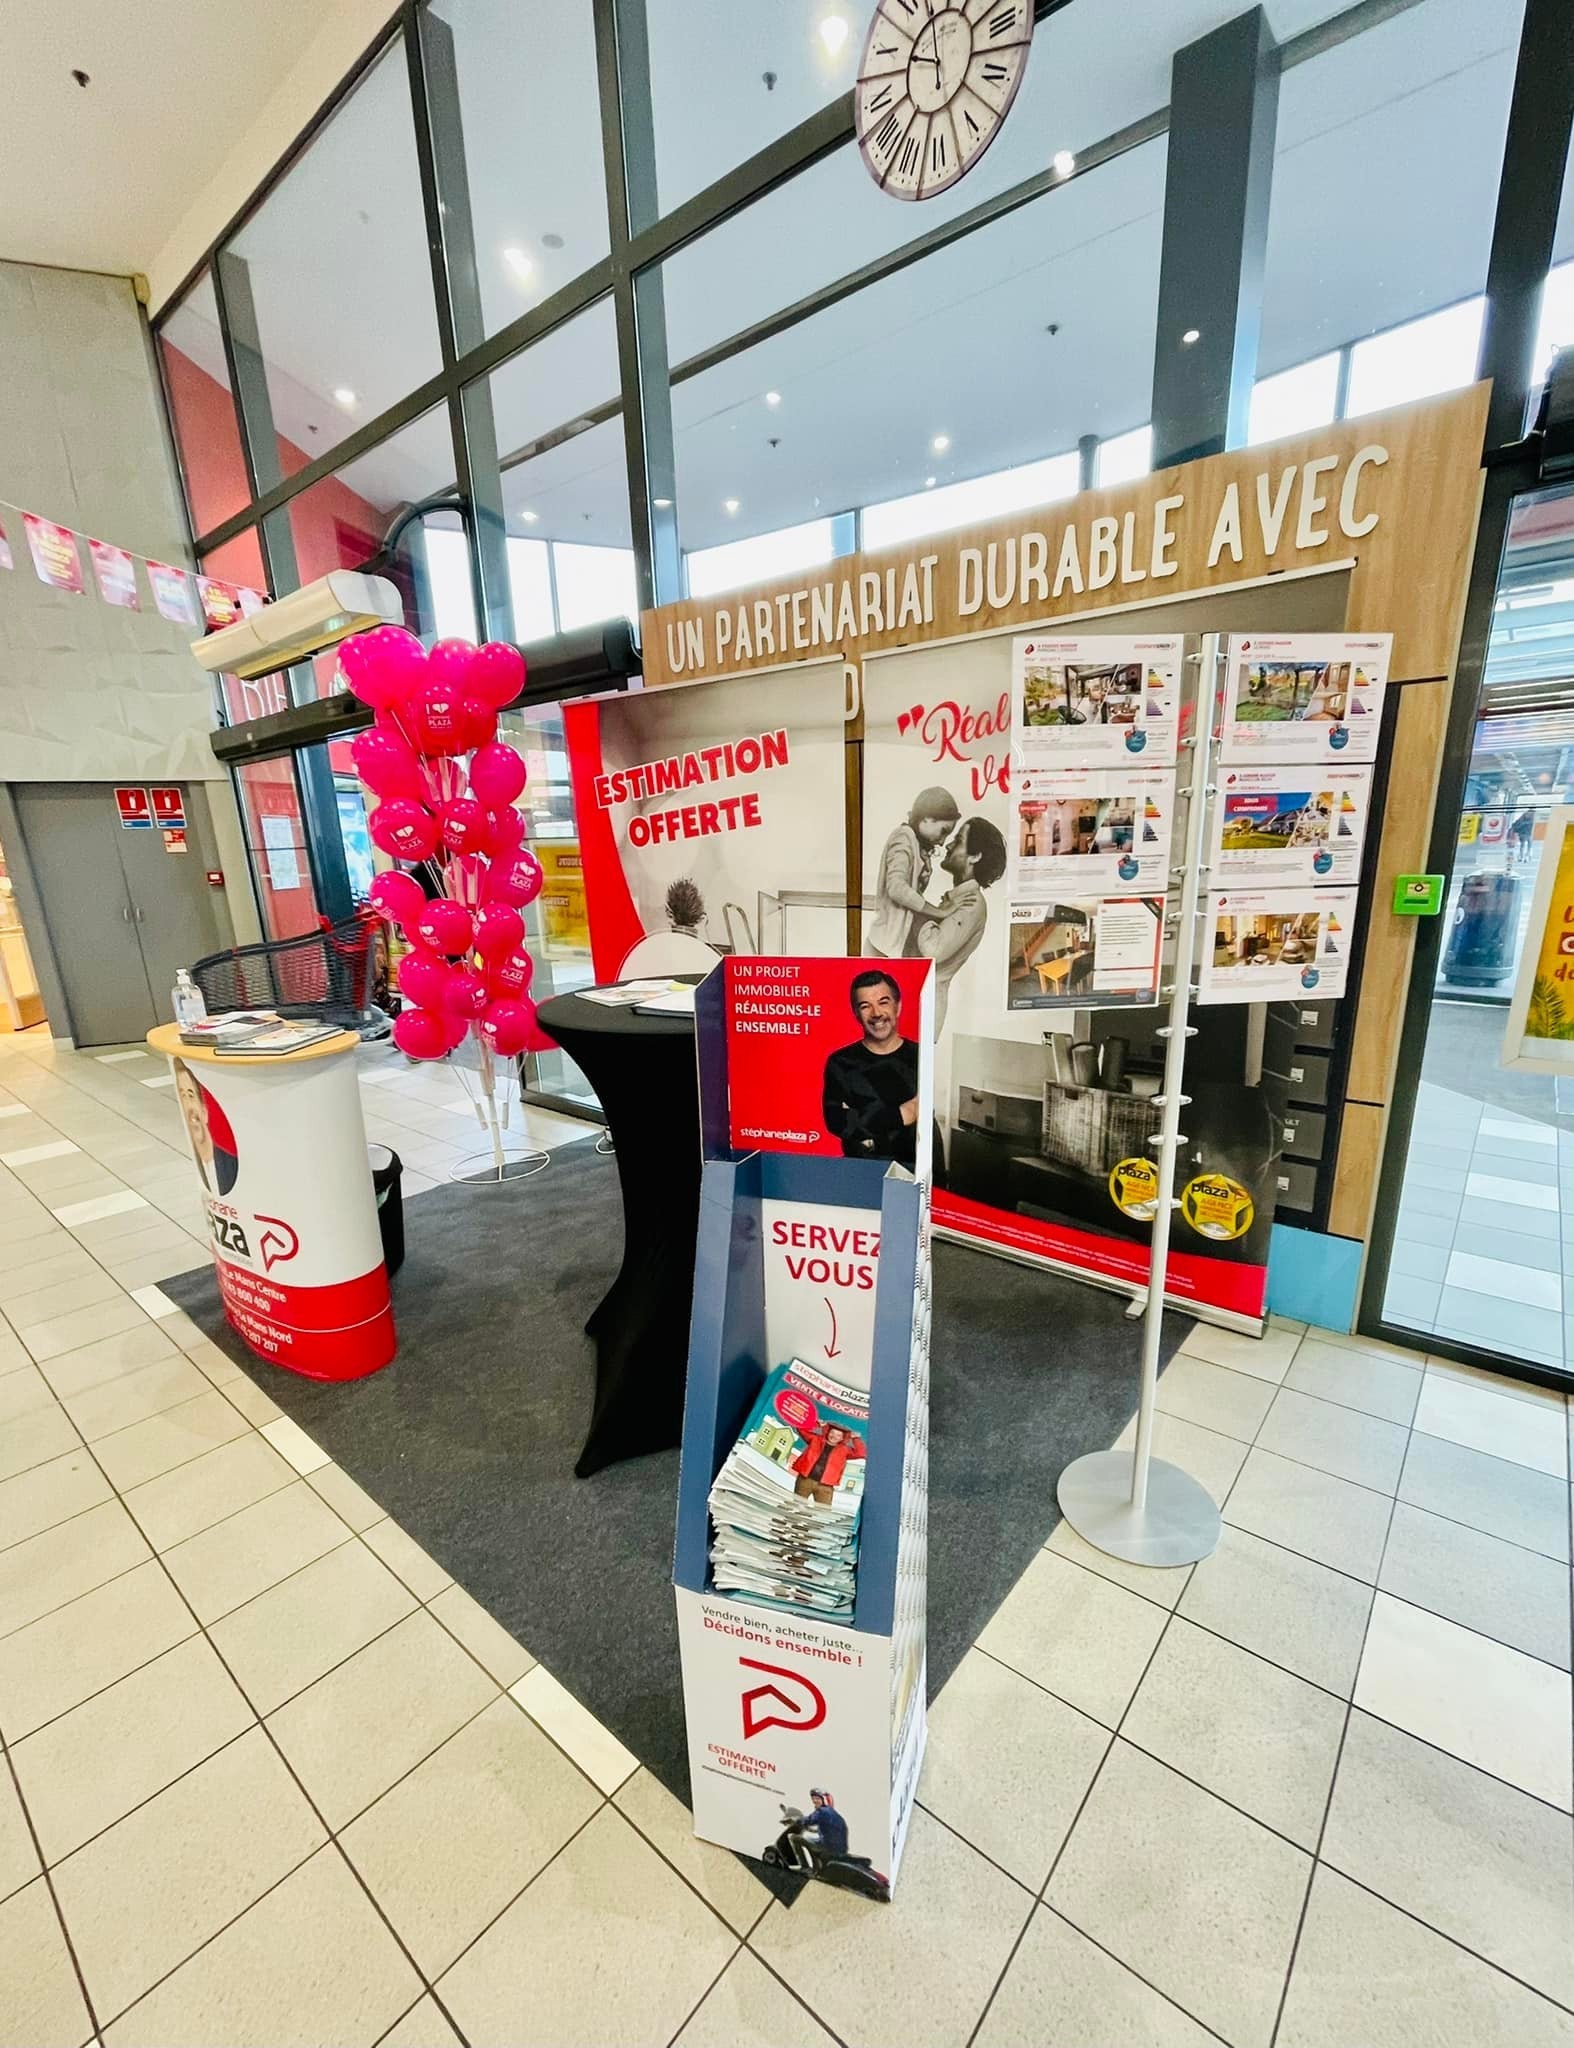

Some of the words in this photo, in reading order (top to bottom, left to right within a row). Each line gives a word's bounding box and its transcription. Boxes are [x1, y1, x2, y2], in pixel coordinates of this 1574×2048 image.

[667, 616, 704, 673] UN
[716, 555, 938, 664] PARTENARIAT
[958, 494, 1184, 616] DURABLE
[1207, 444, 1389, 568] AVEC
[594, 728, 788, 808] ESTIMATION
[628, 792, 763, 848] OFFERTE
[501, 969, 524, 981] PLAZA
[733, 965, 752, 977] UN
[755, 966, 800, 979] PROJET
[734, 984, 810, 998] IMMOBILIER
[735, 1000, 821, 1018] RÉALISONS-LE
[735, 1020, 801, 1035] ENSEMBLE
[1118, 1165, 1151, 1182] plaza
[1191, 1182, 1229, 1199] plaza
[772, 1219, 880, 1259] SERVEZ
[785, 1254, 874, 1290] VOUS
[256, 1281, 287, 1303] Centre
[267, 1325, 293, 1345] Nord
[789, 1376, 819, 1399] VENTE
[701, 1604, 741, 1624] Vendre
[743, 1616, 772, 1633] bien,
[775, 1625, 819, 1643] acheter
[822, 1636, 863, 1654] juste...
[703, 1616, 771, 1646] Décidons
[775, 1638, 852, 1666] ensemble
[707, 1743, 777, 1773] ESTIMATION
[718, 1756, 766, 1779] OFFERTE
